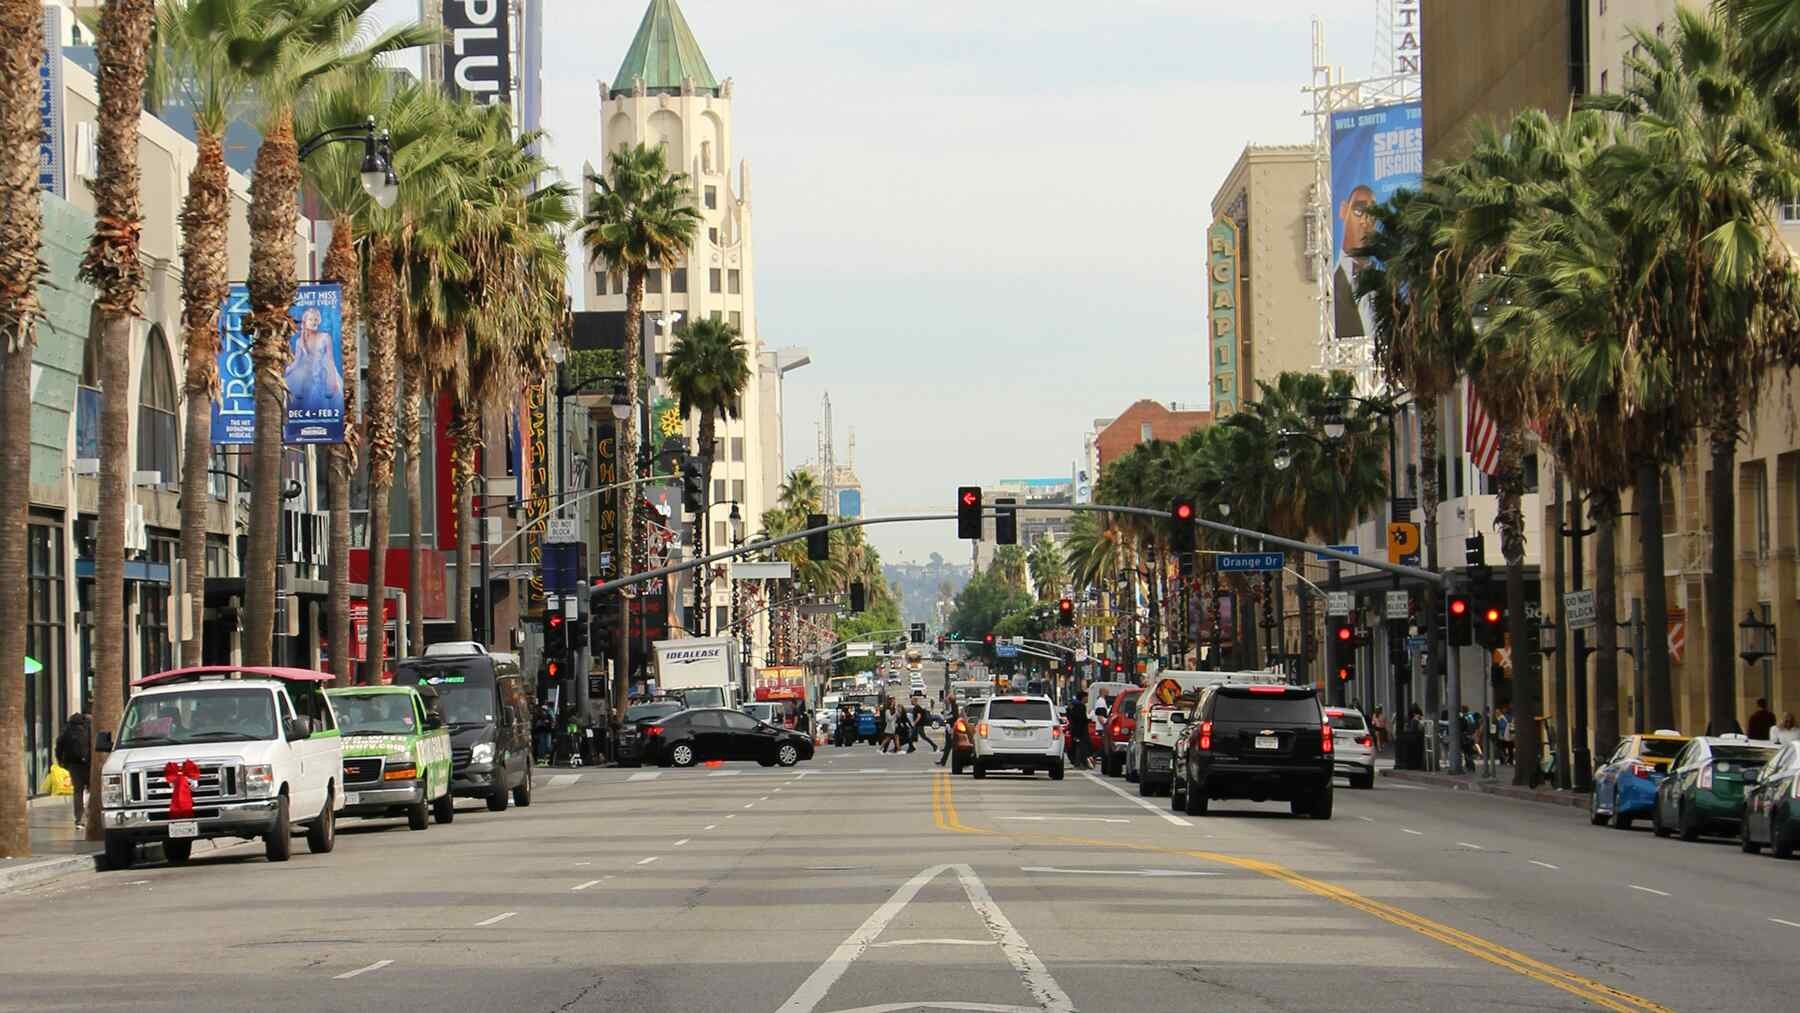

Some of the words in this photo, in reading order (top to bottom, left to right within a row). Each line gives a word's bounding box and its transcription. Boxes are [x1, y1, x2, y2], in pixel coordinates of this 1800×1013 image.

[1396, 0, 1418, 73] TAN
[1336, 117, 1355, 129] WILL
[1358, 112, 1386, 126] SMITH
[1212, 236, 1233, 257] EL
[318, 290, 337, 300] MISS
[219, 292, 254, 416] FROZEN
[289, 409, 303, 418] DEC
[305, 409, 310, 417] 4
[318, 408, 333, 417] FEB
[334, 408, 340, 417] 2
[1222, 557, 1261, 567] Orange
[1265, 555, 1278, 566] Dr
[1567, 597, 1577, 607] DO
[1568, 606, 1594, 618] BLOCK
[666, 649, 721, 659] IDEALEASE
